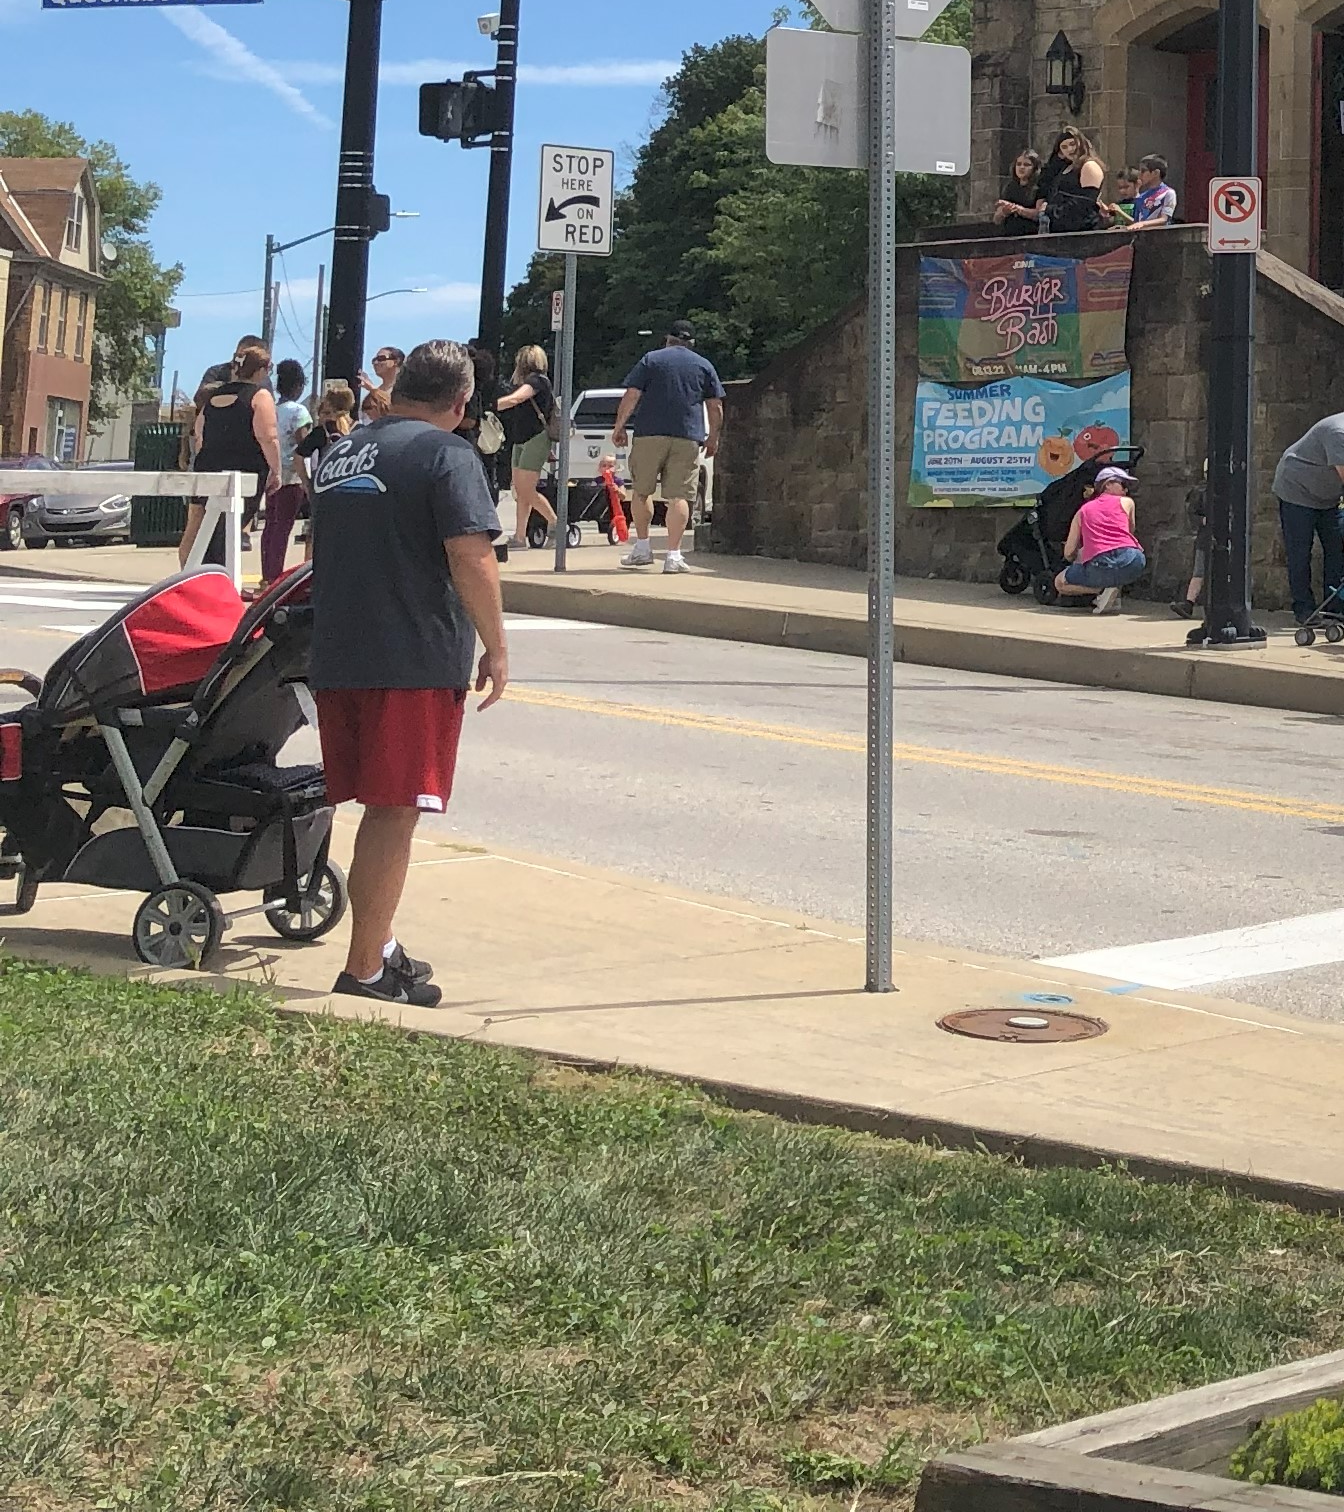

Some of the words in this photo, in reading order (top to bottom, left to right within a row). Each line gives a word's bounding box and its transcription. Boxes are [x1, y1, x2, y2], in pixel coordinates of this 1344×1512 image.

[552, 153, 605, 176] STOP
[561, 178, 593, 191] HERE
[577, 208, 593, 220] ON
[565, 223, 604, 245] RED
[947, 384, 1012, 400] SUMMER
[922, 395, 1045, 428] FEEDING
[923, 425, 1044, 452] PROGRAM
[970, 456, 1004, 465] AUGUST
[1006, 456, 1031, 464] 25TH
